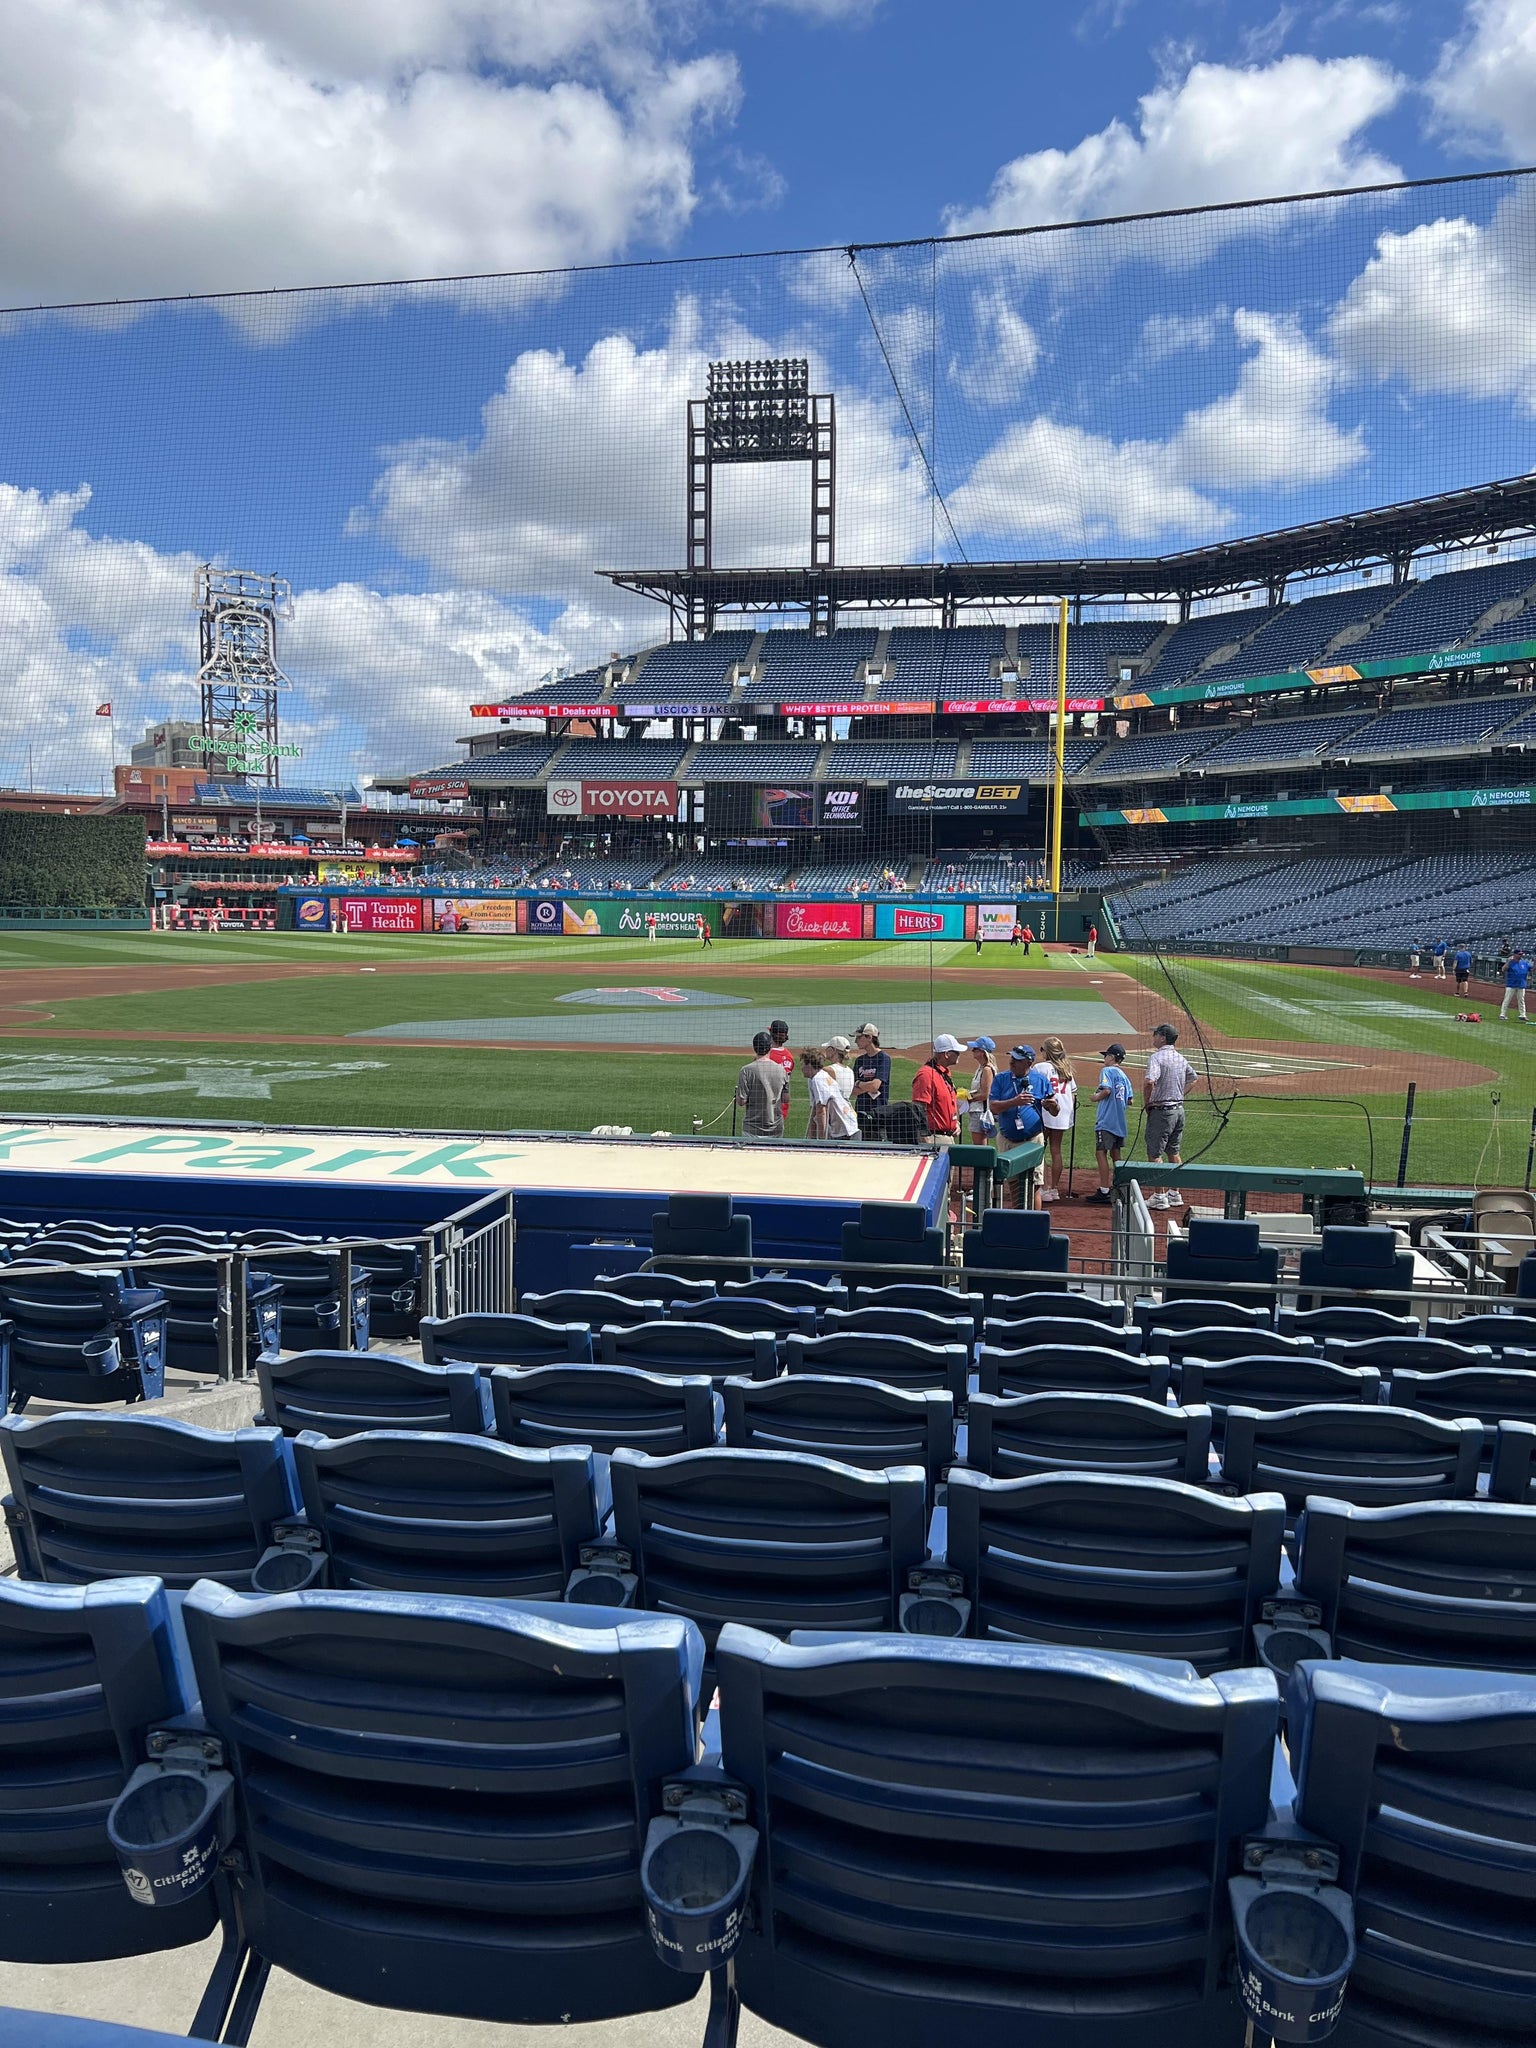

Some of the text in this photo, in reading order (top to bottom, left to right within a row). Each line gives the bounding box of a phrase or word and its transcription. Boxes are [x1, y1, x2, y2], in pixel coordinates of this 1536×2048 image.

[1445, 652, 1481, 662] NEMOURS
[1217, 683, 1245, 692] NEMOURS
[497, 706, 610, 715] Phillies win Deals roll in
[654, 705, 698, 714] LISCIO'S
[785, 704, 812, 713] WHEY
[815, 704, 848, 713] BETTER
[850, 703, 889, 712] PROTEIN
[188, 735, 301, 758] Citizens Bank
[227, 756, 263, 773] Park
[413, 781, 466, 796] HIT THIS SIGN
[895, 785, 1017, 799] theScore BET
[1490, 791, 1530, 800] NEMOURS
[587, 789, 669, 806] TOYOTA
[824, 791, 859, 805] KDI
[346, 902, 367, 927] T
[371, 902, 417, 917] Temple
[542, 908, 550, 916] R
[645, 912, 702, 922] NEMOURS
[372, 917, 415, 929] Health
[786, 910, 851, 934] Chick-fil-A
[983, 913, 1012, 922] WM
[1050, 1077, 1068, 1095] 27
[71, 1135, 529, 1178] Park
[153, 1861, 201, 1888] Citizens
[180, 1866, 206, 1889] Park
[658, 1931, 684, 1953] Bank
[1262, 2000, 1295, 2024] Bank
